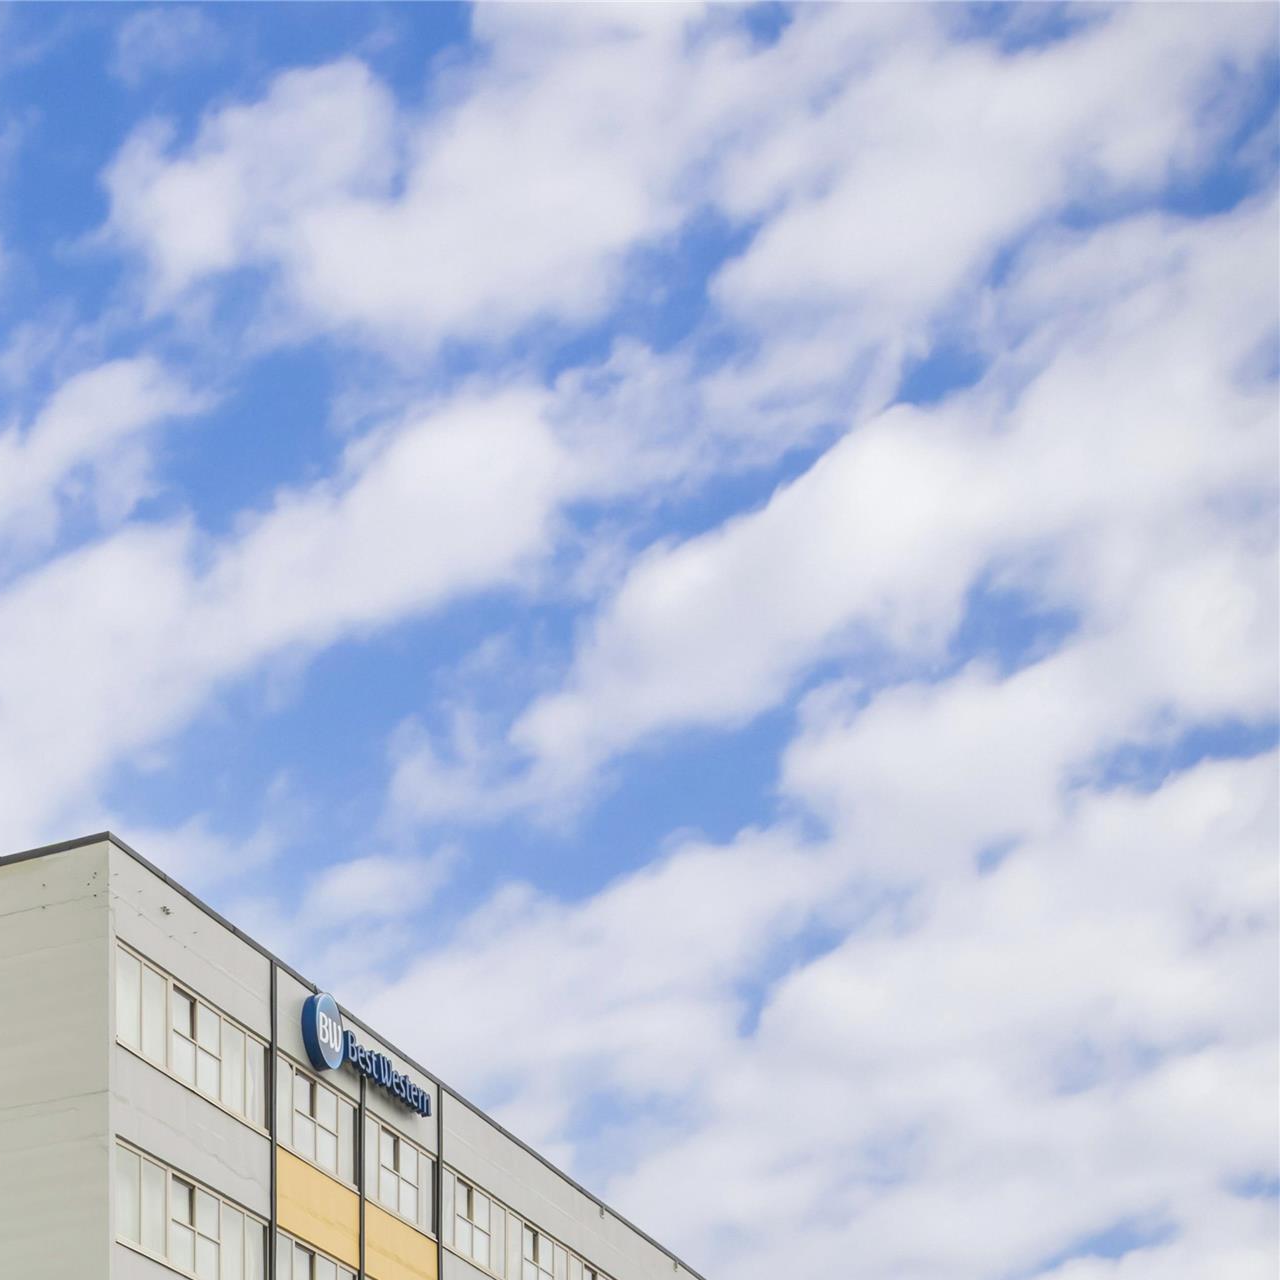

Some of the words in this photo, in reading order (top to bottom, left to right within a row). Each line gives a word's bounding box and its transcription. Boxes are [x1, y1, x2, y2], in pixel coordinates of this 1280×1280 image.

[319, 1011, 341, 1053] BW
[346, 1030, 378, 1079] Best
[380, 1053, 431, 1116] Western
